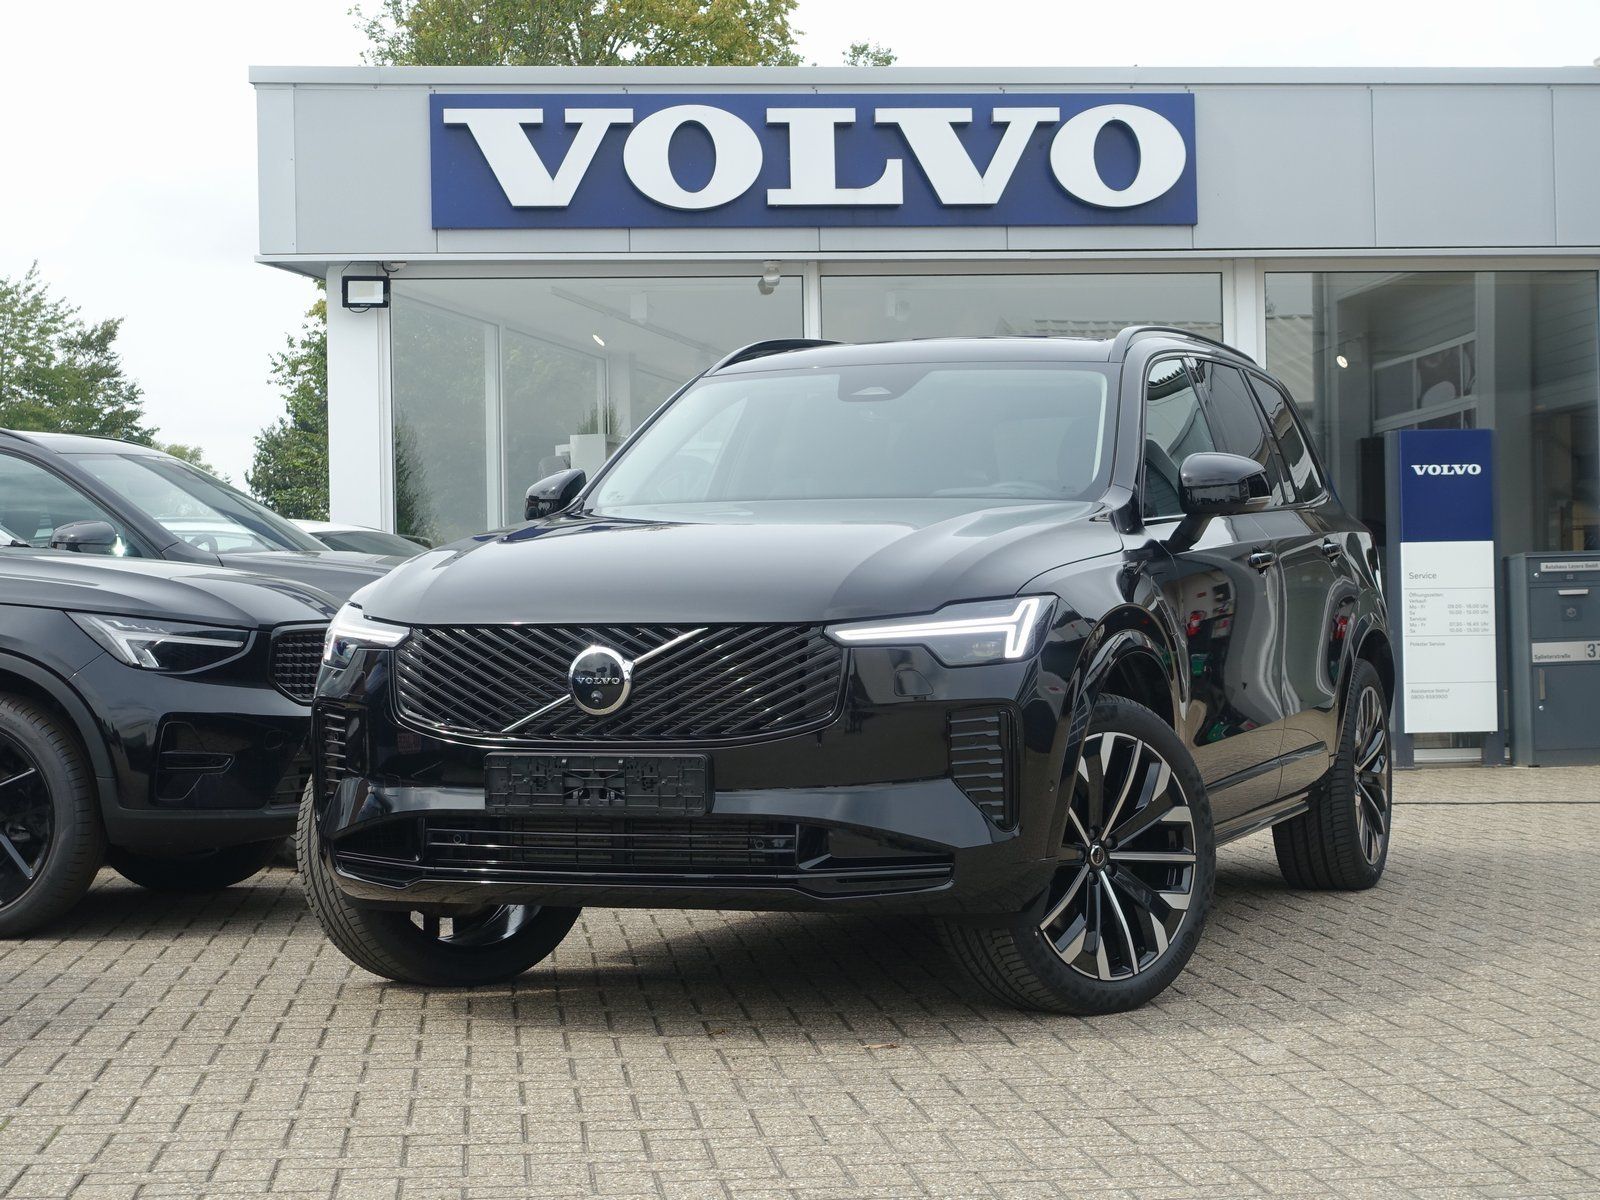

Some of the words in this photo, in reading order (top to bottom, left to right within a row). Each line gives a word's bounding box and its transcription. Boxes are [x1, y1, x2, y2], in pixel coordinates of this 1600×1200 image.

[443, 103, 1187, 211] VOLVO
[1411, 463, 1482, 476] VOLVO
[1409, 571, 1437, 580] Service
[1587, 643, 1600, 658] 3
[575, 677, 620, 685] VOLVO
